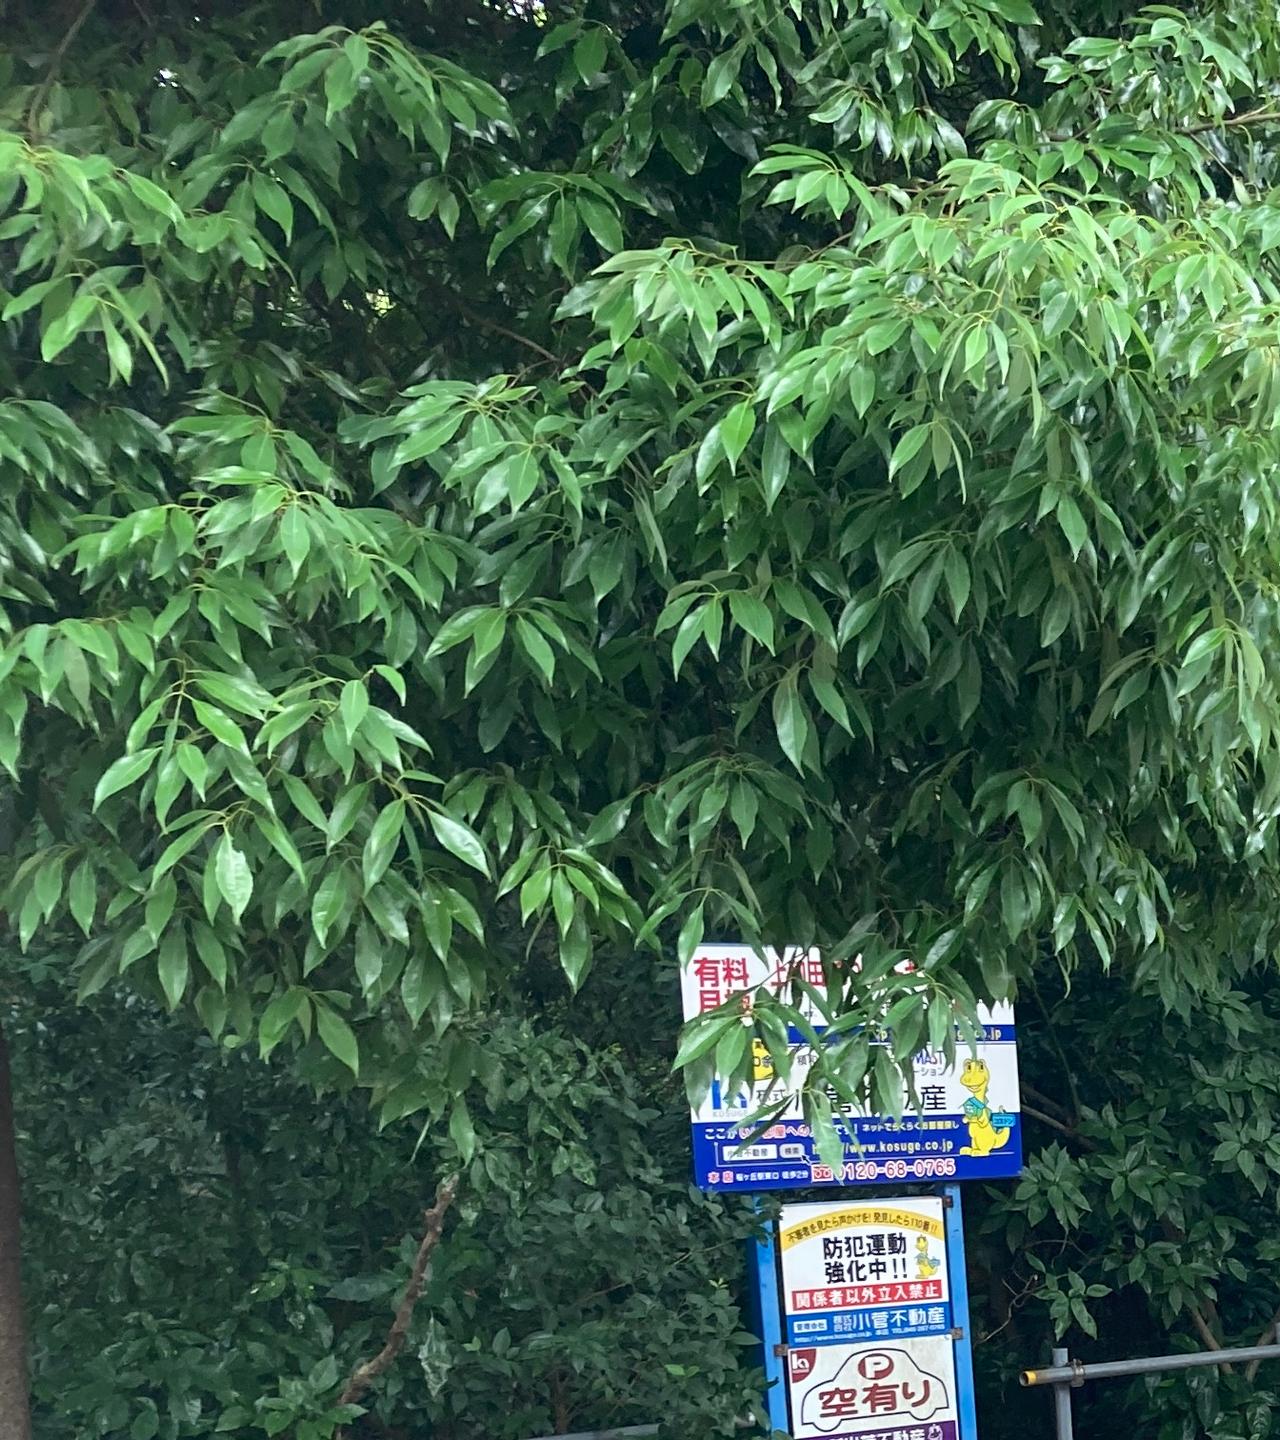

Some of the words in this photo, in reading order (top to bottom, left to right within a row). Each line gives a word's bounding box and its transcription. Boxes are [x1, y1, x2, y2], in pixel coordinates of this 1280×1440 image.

[693, 957, 750, 988] 有料
[823, 1232, 907, 1260] 防犯運動
[795, 1285, 940, 1309] 関係者以外立入禁止
[864, 1356, 891, 1379] P
[818, 1379, 930, 1418] 空有り
